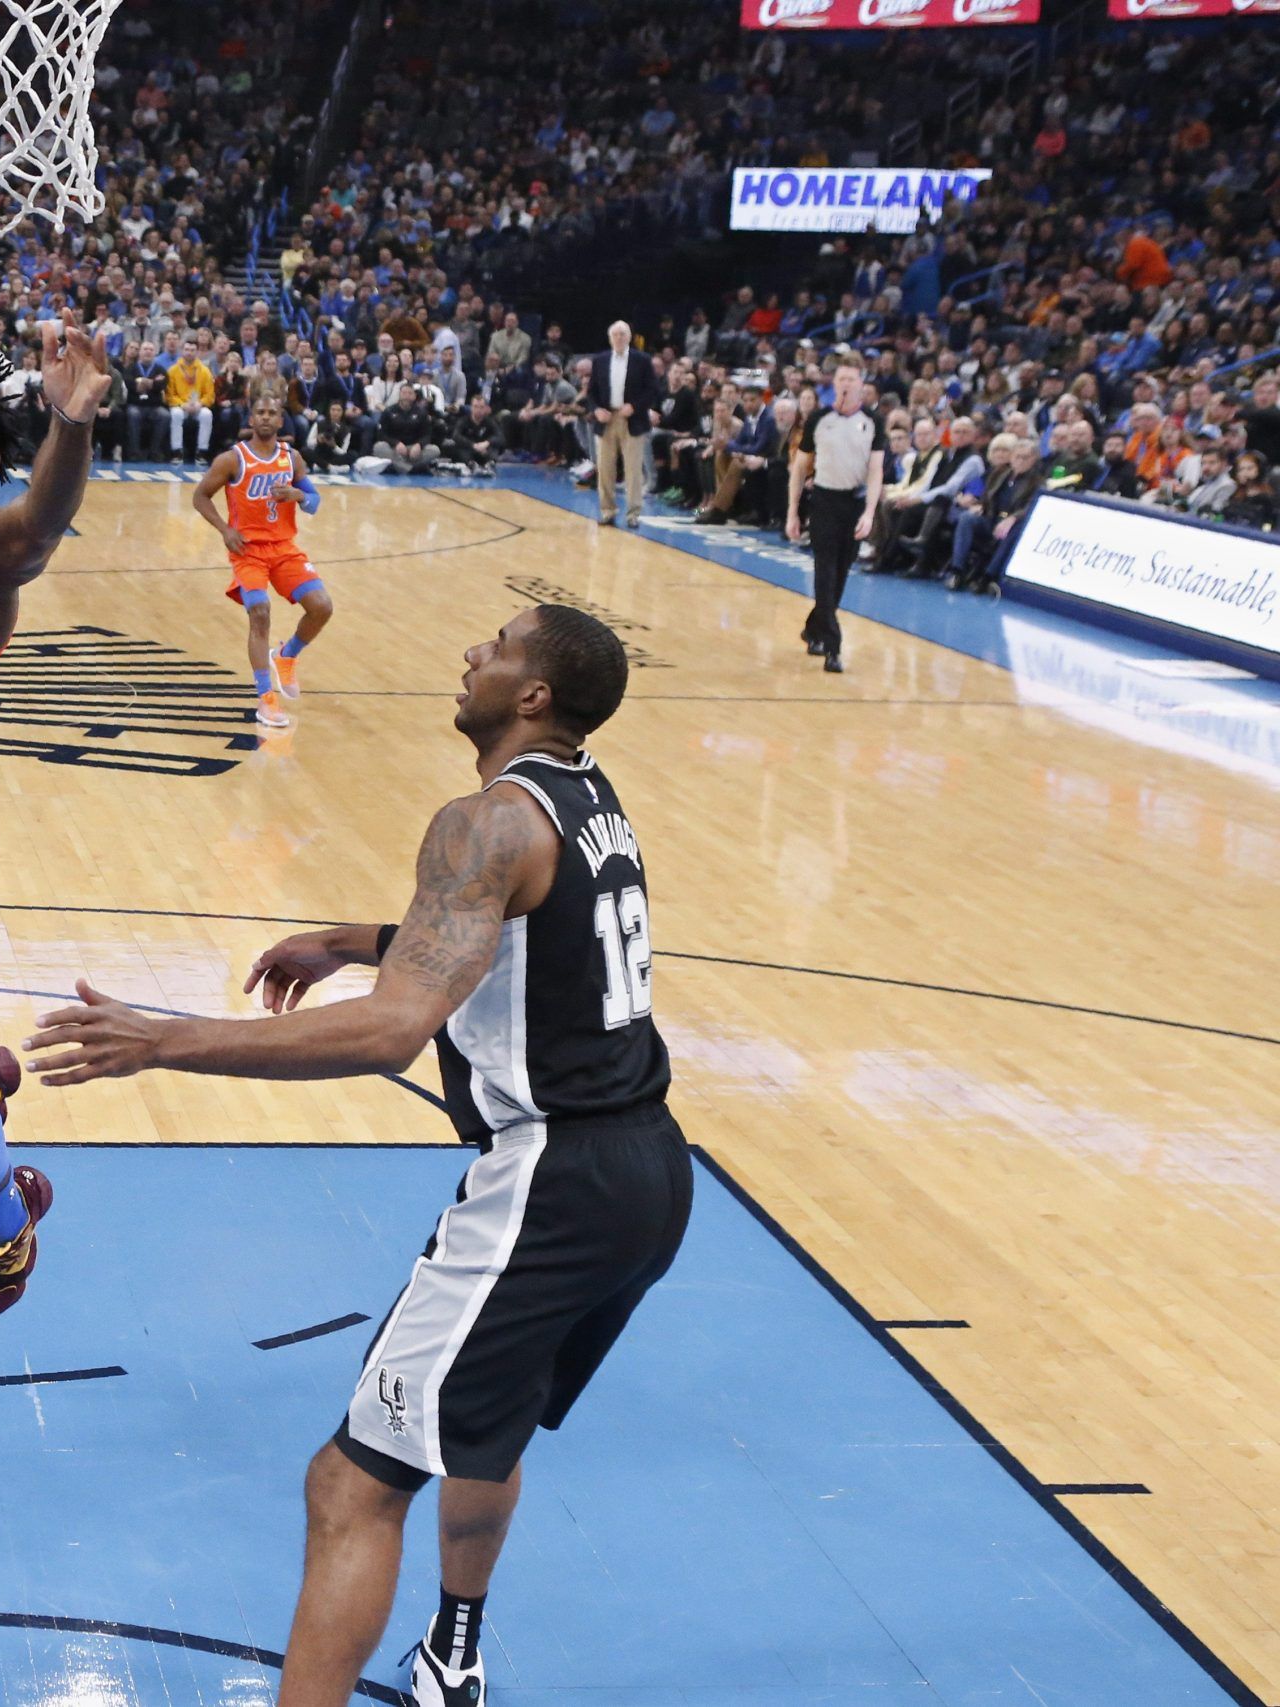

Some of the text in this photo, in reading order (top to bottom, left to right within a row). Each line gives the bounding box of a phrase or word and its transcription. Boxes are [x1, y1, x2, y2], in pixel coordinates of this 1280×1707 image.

[739, 172, 979, 208] HOMELAND
[1140, 549, 1276, 626] Sustainable,
[593, 884, 653, 1031] 12
